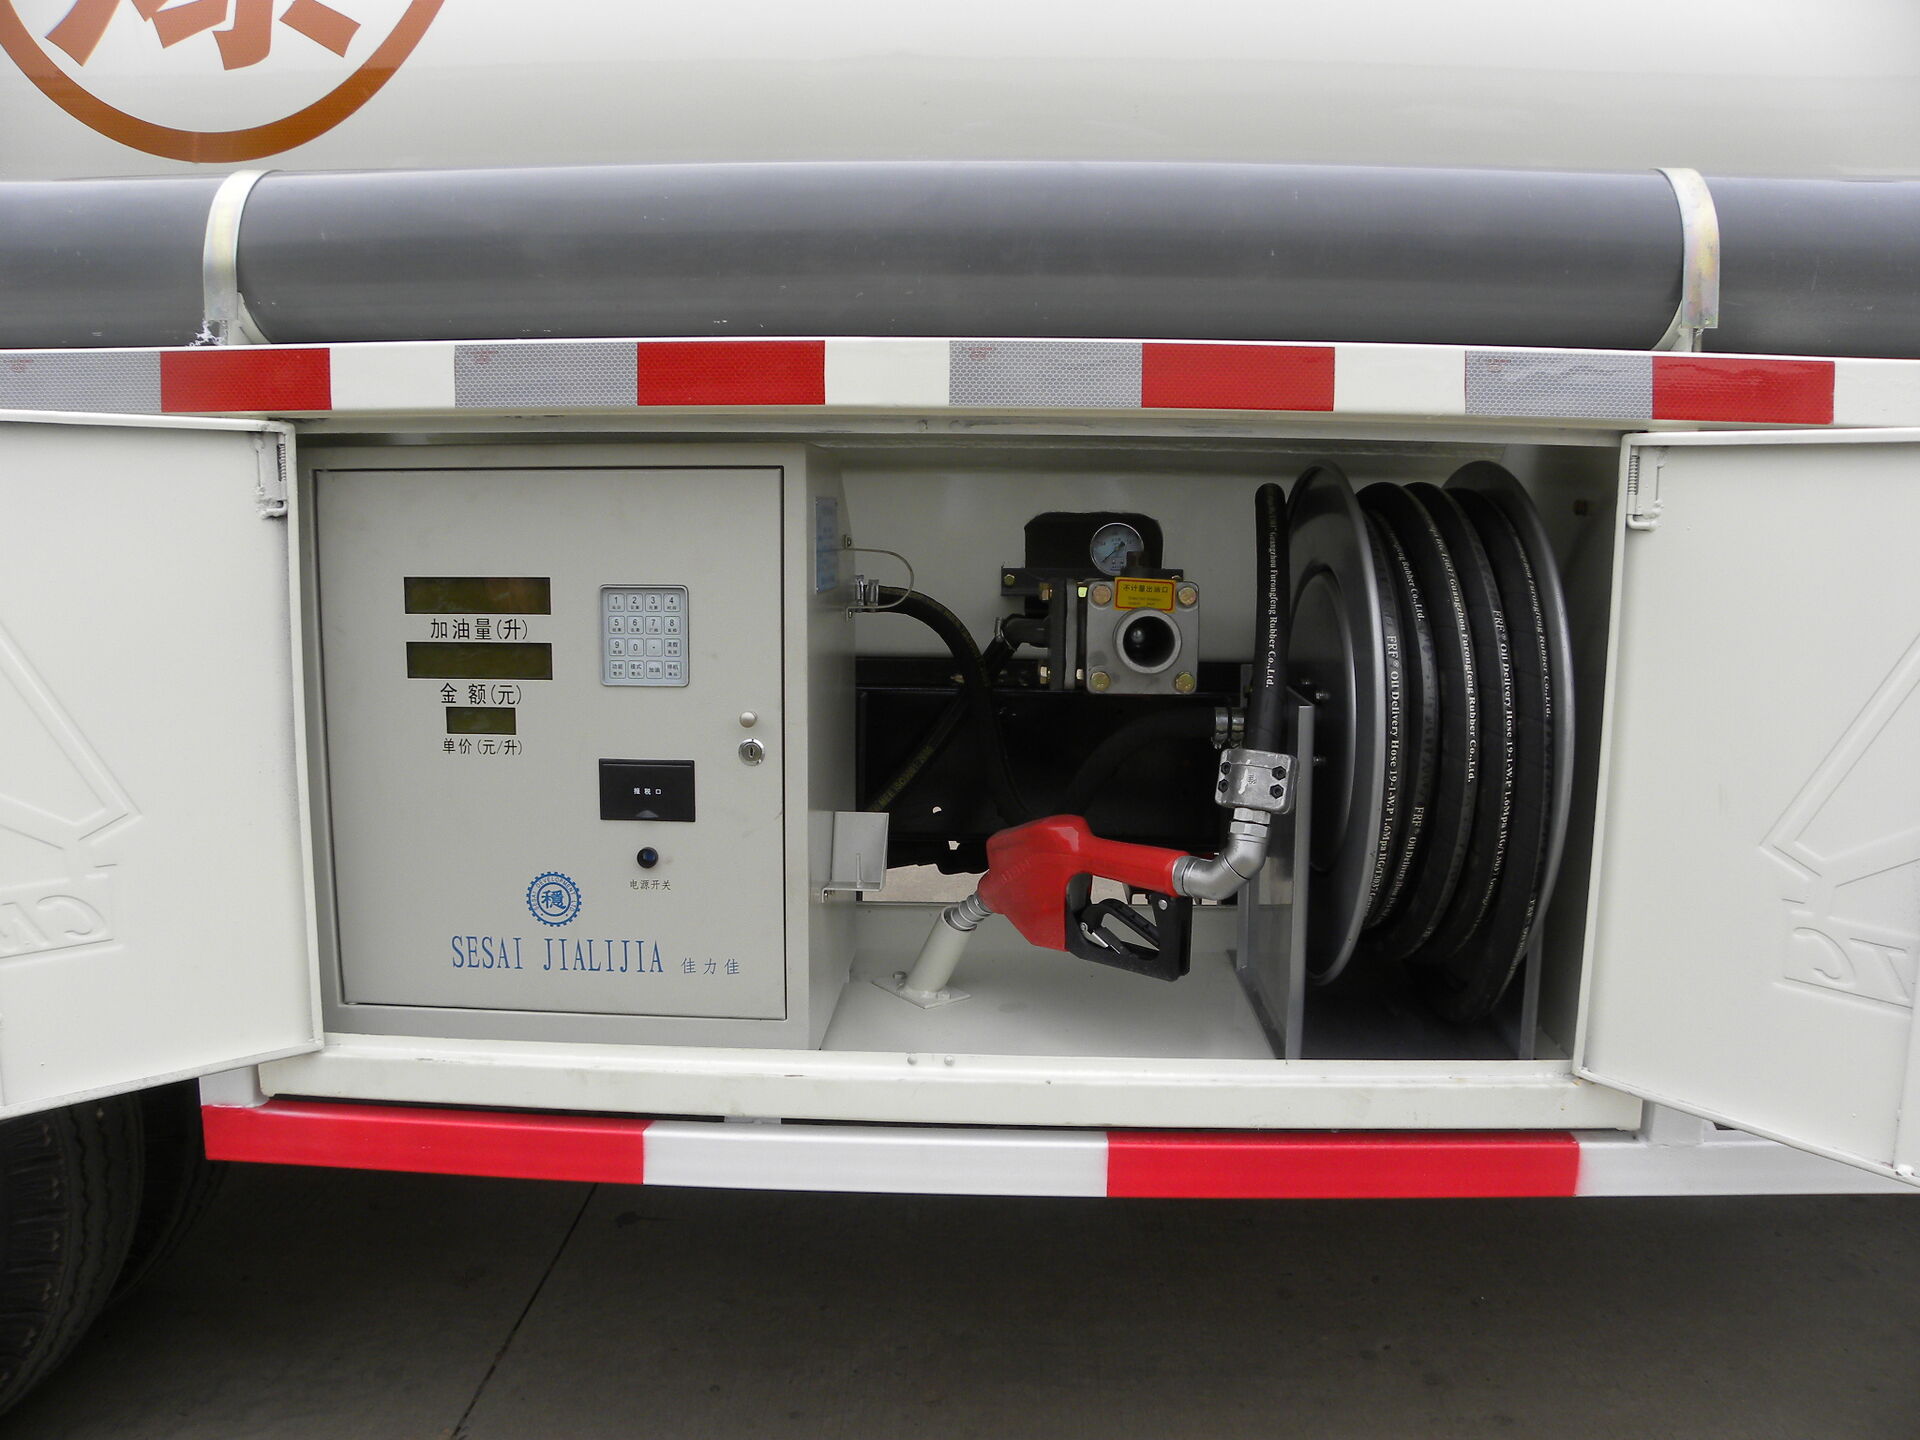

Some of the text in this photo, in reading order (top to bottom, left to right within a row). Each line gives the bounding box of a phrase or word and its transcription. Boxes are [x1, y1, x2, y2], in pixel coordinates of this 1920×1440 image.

[430, 618, 528, 640] 加油量(升)
[1268, 616, 1278, 649] Rubber
[1502, 662, 1512, 708] Delivery
[1390, 691, 1401, 738] Delivery
[1468, 696, 1477, 737] Rubber
[1505, 710, 1514, 739] Hose
[442, 738, 523, 756] 单价(元/升)
[1389, 739, 1400, 768] Hose
[629, 879, 672, 891] 电源开关
[451, 935, 664, 973] SESAI JIALIJIA
